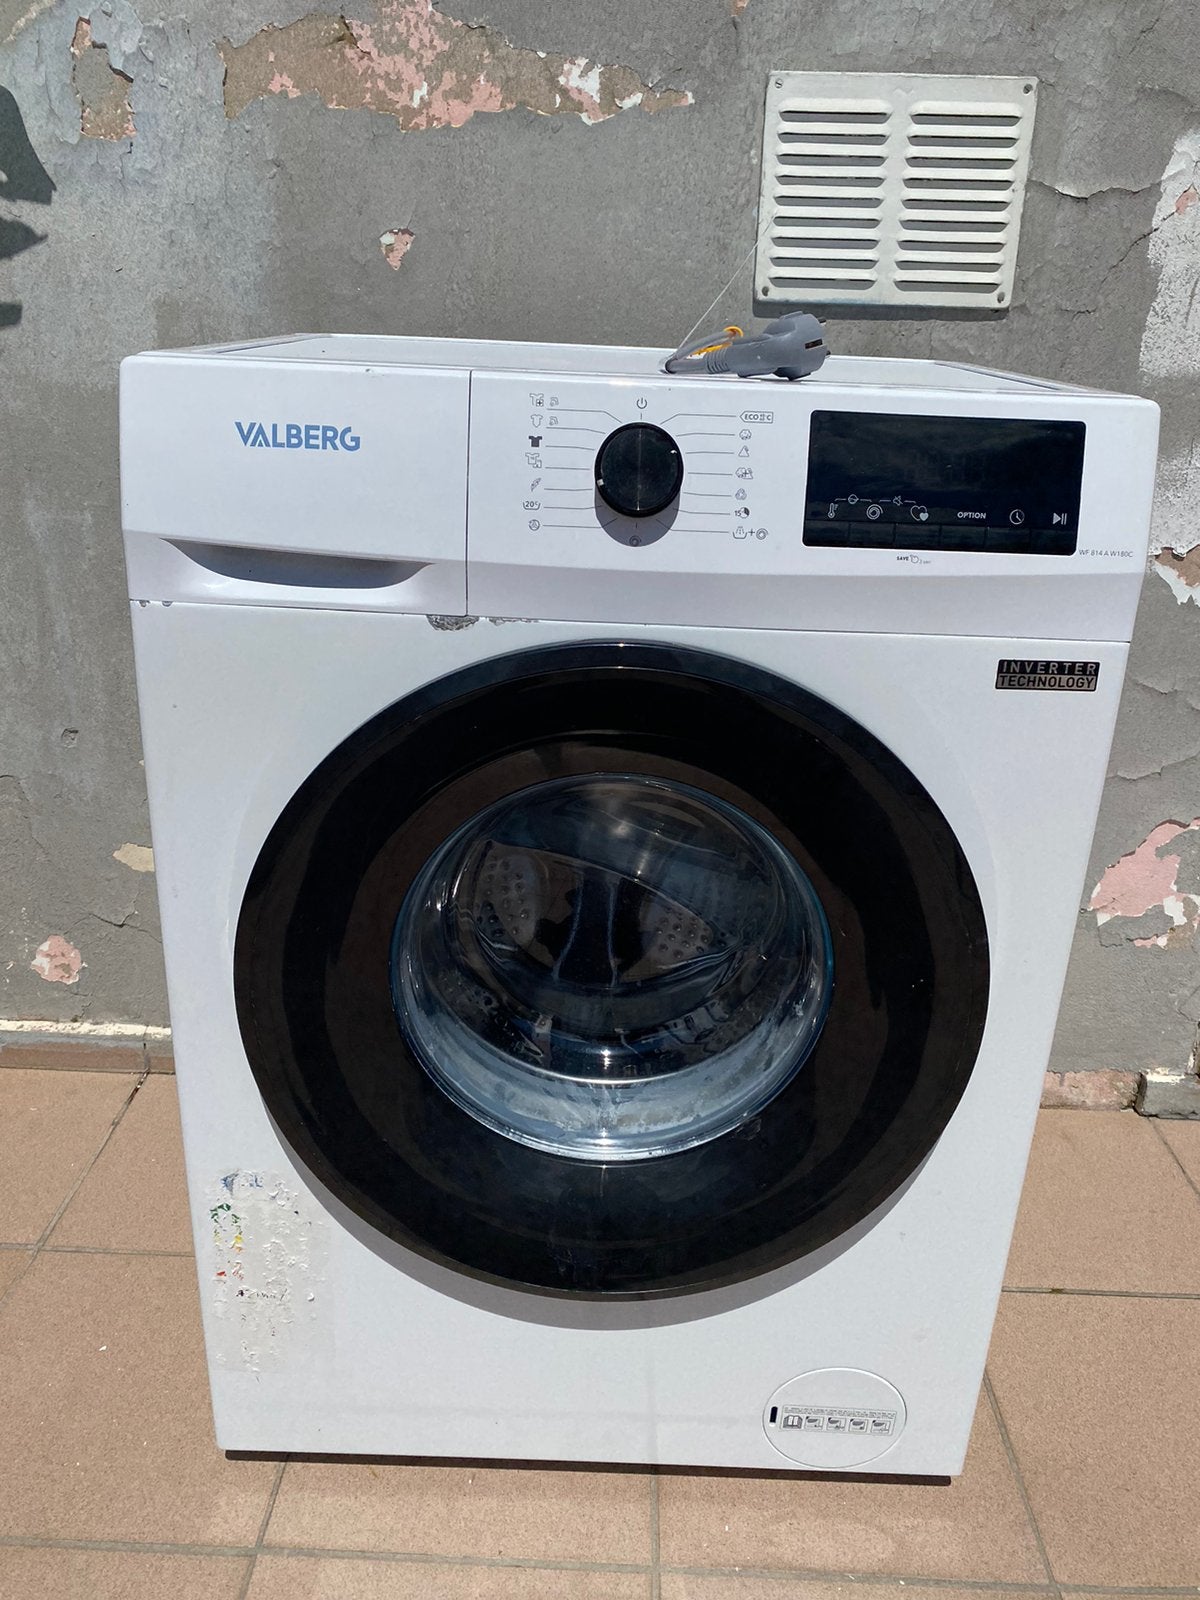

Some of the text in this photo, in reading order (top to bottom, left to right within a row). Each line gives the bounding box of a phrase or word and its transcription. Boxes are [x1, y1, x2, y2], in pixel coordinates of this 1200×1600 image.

[234, 421, 361, 451] VALBERG
[957, 511, 987, 519] OPTION
[1002, 661, 1097, 675] INVERTER
[999, 675, 1095, 689] TECHNOLOGY
